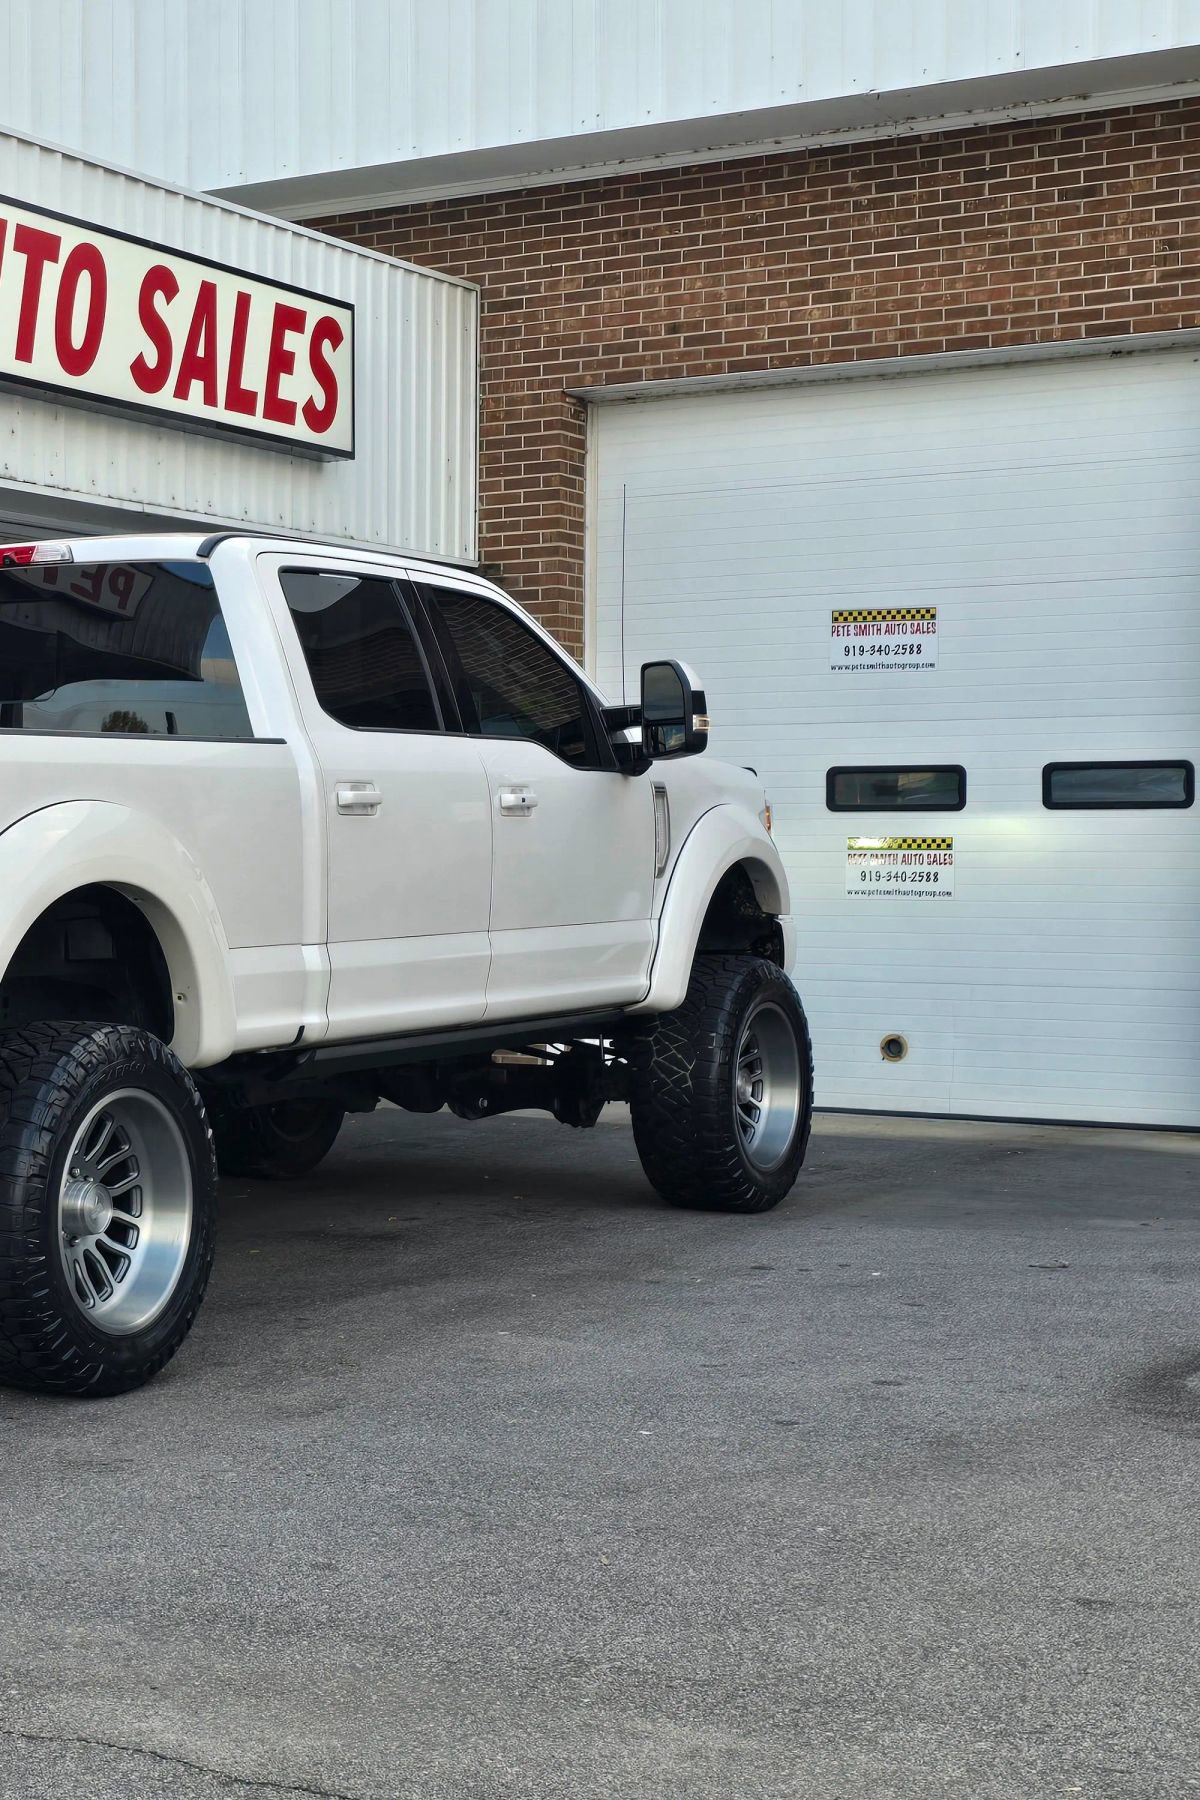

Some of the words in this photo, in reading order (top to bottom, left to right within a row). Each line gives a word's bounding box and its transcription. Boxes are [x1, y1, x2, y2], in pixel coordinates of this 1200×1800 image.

[129, 264, 344, 434] SALES
[831, 624, 851, 637] PETE
[853, 623, 882, 637] SMITH
[884, 623, 908, 636] AUTO
[910, 622, 937, 635] SALES
[844, 643, 922, 657] 919-340-2588
[830, 661, 936, 672] www.petesmithautogroup.com
[901, 853, 925, 866] AUTO
[926, 853, 953, 866] SALES
[860, 870, 939, 883] 919-340-2588
[847, 888, 953, 898] www.petesmithautogroup.com
